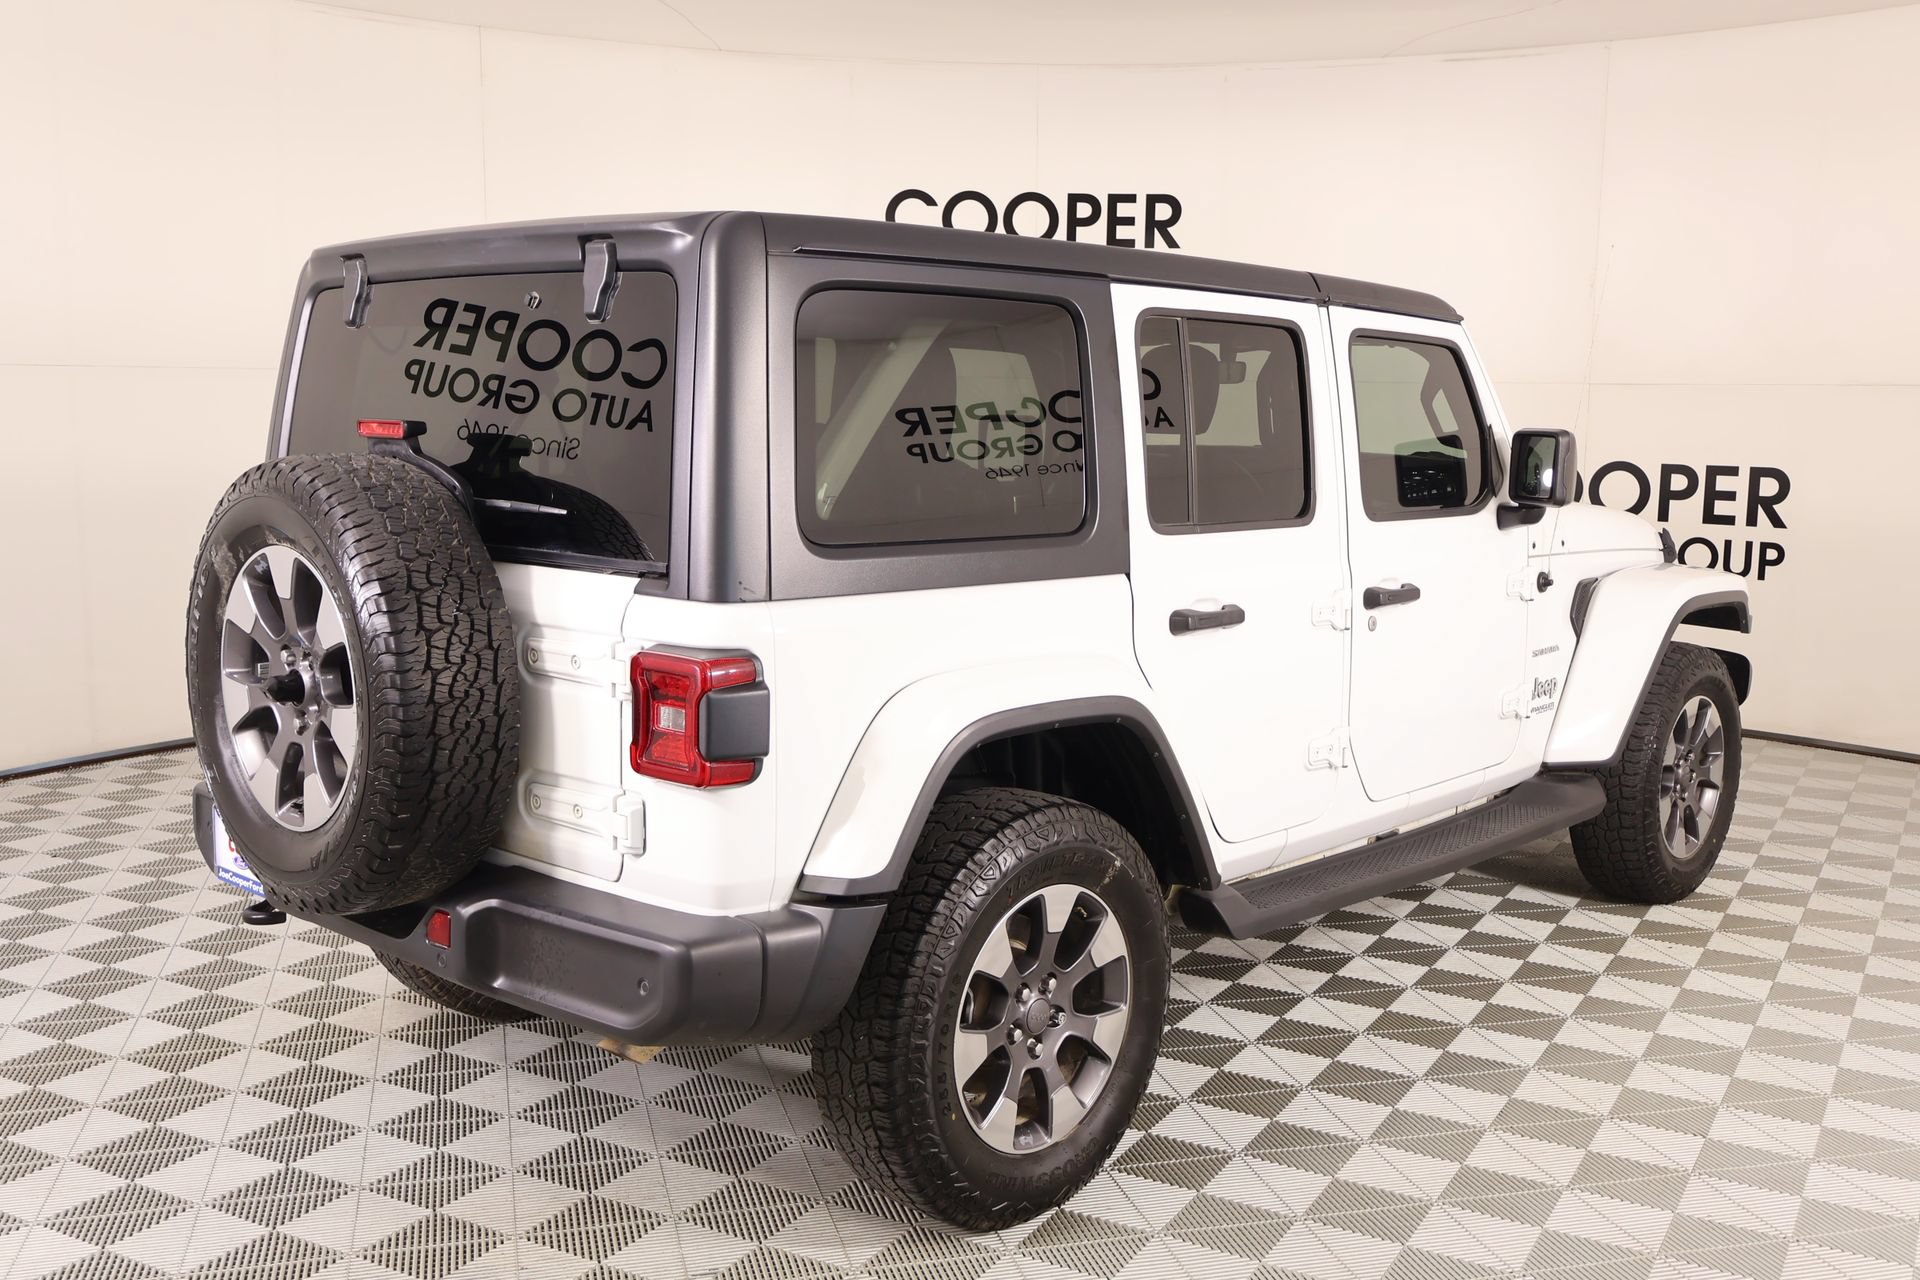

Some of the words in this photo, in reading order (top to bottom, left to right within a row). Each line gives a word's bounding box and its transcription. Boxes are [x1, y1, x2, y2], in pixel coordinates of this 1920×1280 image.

[1575, 460, 1791, 529] OPER
[1677, 536, 1786, 581] OUP
[1531, 677, 1559, 701] Jeep
